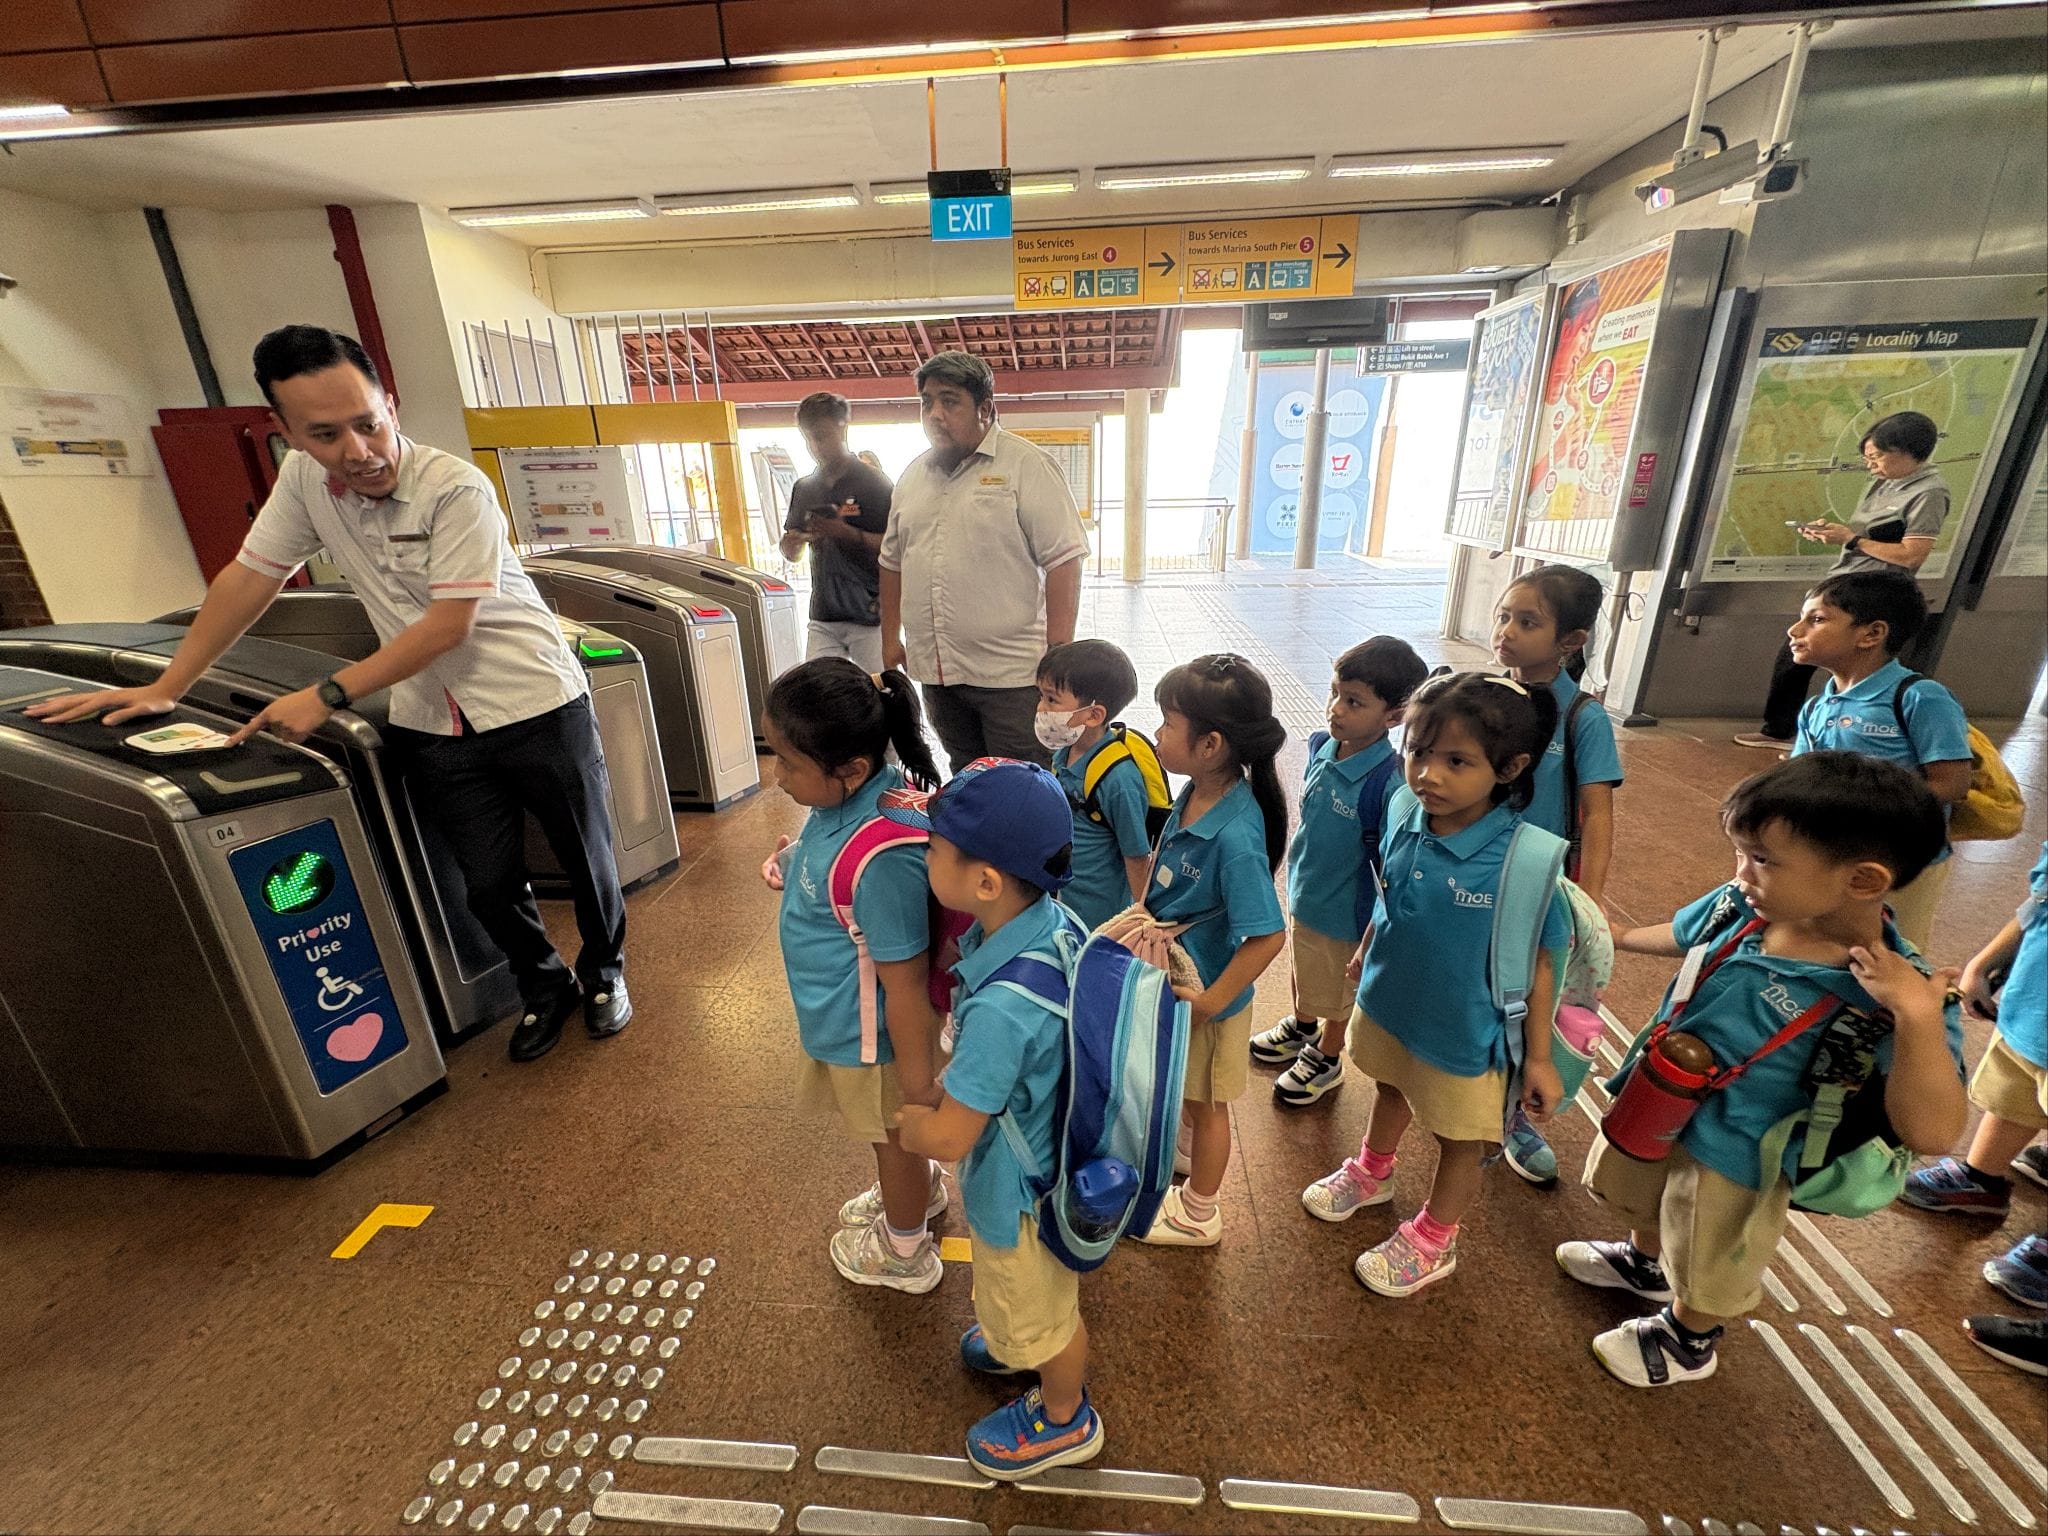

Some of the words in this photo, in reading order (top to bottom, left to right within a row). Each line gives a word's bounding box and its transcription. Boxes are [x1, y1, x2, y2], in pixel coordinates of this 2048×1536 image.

[947, 203, 994, 232] EXIT
[1188, 230, 1206, 241] Bus
[1208, 228, 1248, 240] Services
[1017, 240, 1034, 250] Bus
[1036, 237, 1075, 249] Services
[1188, 246, 1221, 255] towards
[1222, 244, 1251, 254] Marina
[1254, 242, 1278, 252] South
[1280, 242, 1297, 251] Pier
[1018, 253, 1049, 263] towards
[1052, 252, 1079, 263] Jurong
[1081, 251, 1098, 261] East
[1247, 271, 1261, 289] A
[1296, 275, 1304, 287] 3
[1077, 279, 1090, 297] A
[1124, 283, 1132, 294] 5
[1602, 315, 1625, 329] Creating
[1626, 307, 1656, 322] memories
[1622, 325, 1639, 341] EAT
[1866, 331, 1922, 348] Locality
[1926, 331, 1959, 346] Map
[1384, 362, 1401, 370] Shops
[216, 826, 235, 841] 04
[1455, 890, 1494, 904] MOE
[305, 939, 343, 963] Use
